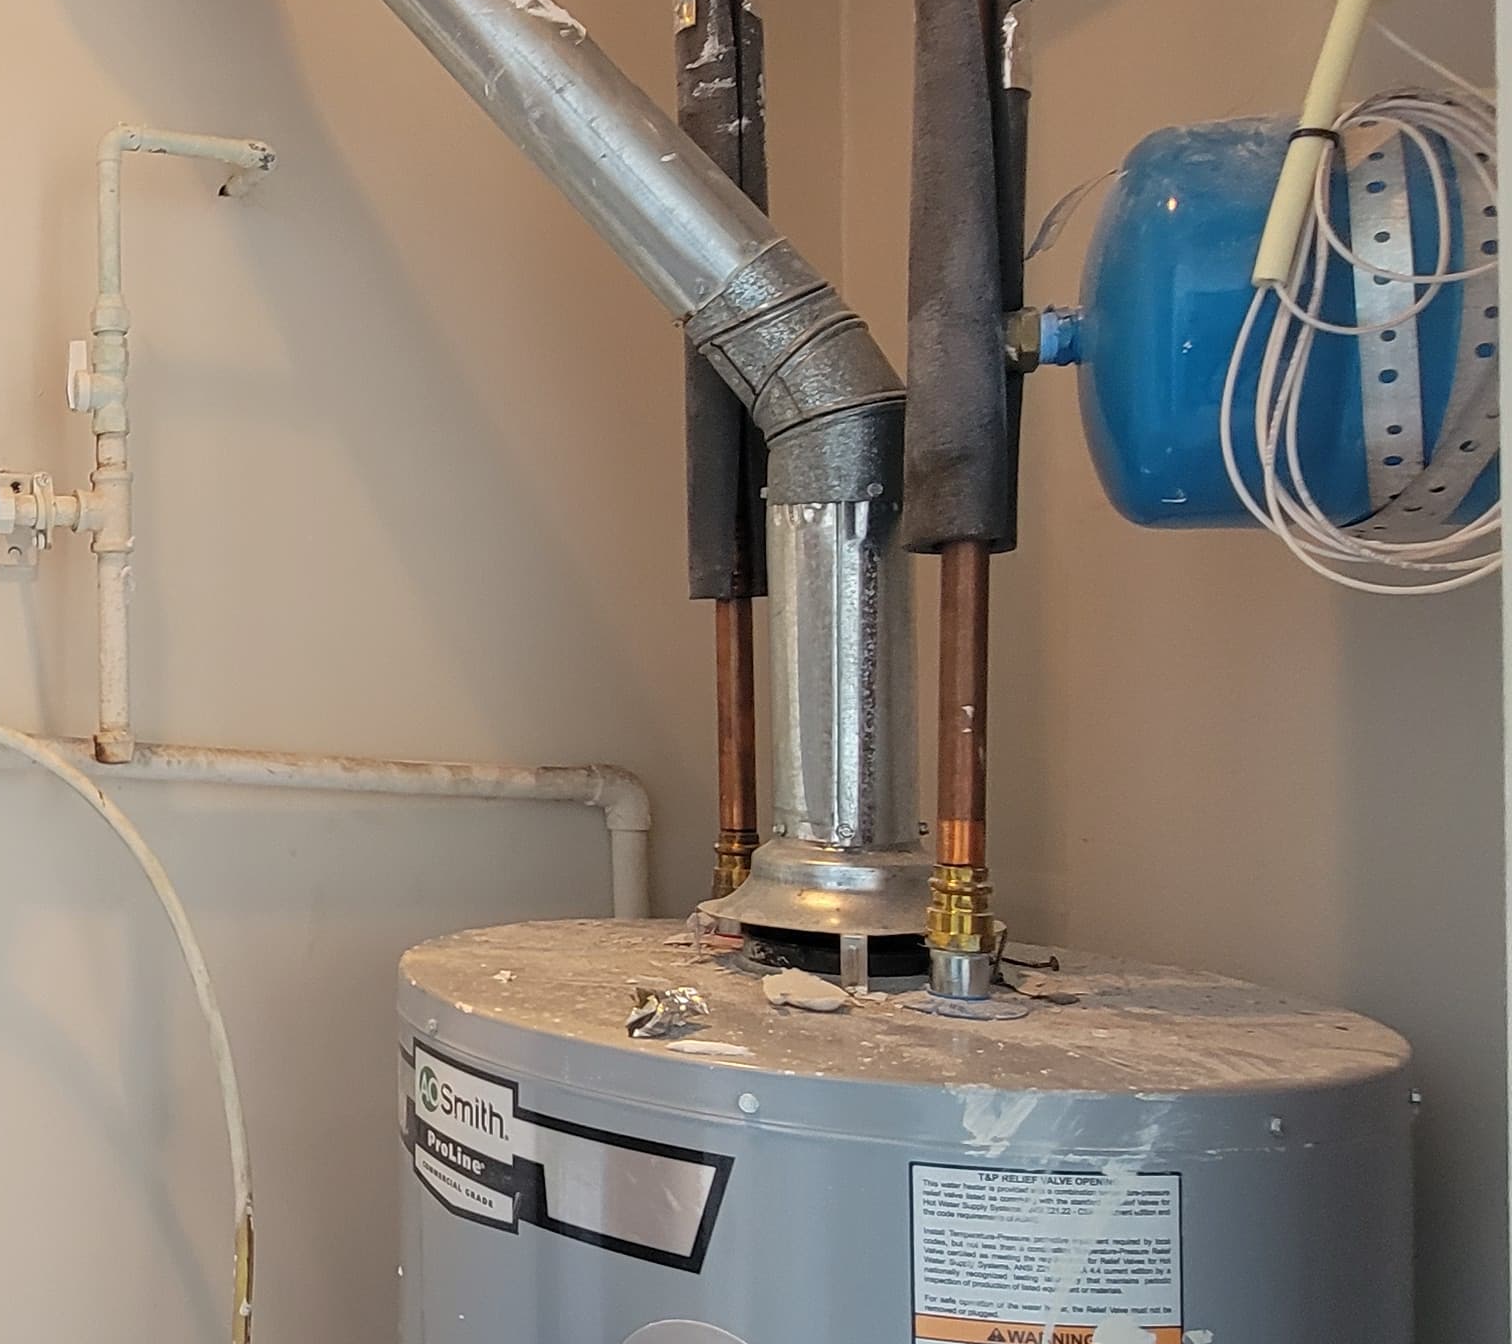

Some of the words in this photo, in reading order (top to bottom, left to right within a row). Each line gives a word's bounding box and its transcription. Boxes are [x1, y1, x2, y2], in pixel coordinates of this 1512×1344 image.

[441, 1084, 504, 1141] Smith
[428, 1130, 481, 1175] ProLine
[422, 1160, 462, 1192] COMMERCIAL
[465, 1189, 493, 1208] GRADE
[923, 1179, 938, 1187] This
[979, 1173, 998, 1182] T&P
[1002, 1175, 1037, 1184] RELIEF
[1041, 1176, 1072, 1185] ALVE
[939, 1200, 959, 1208] Water
[962, 1202, 987, 1212] Supply
[924, 1294, 937, 1302] For
[940, 1296, 956, 1305] safe
